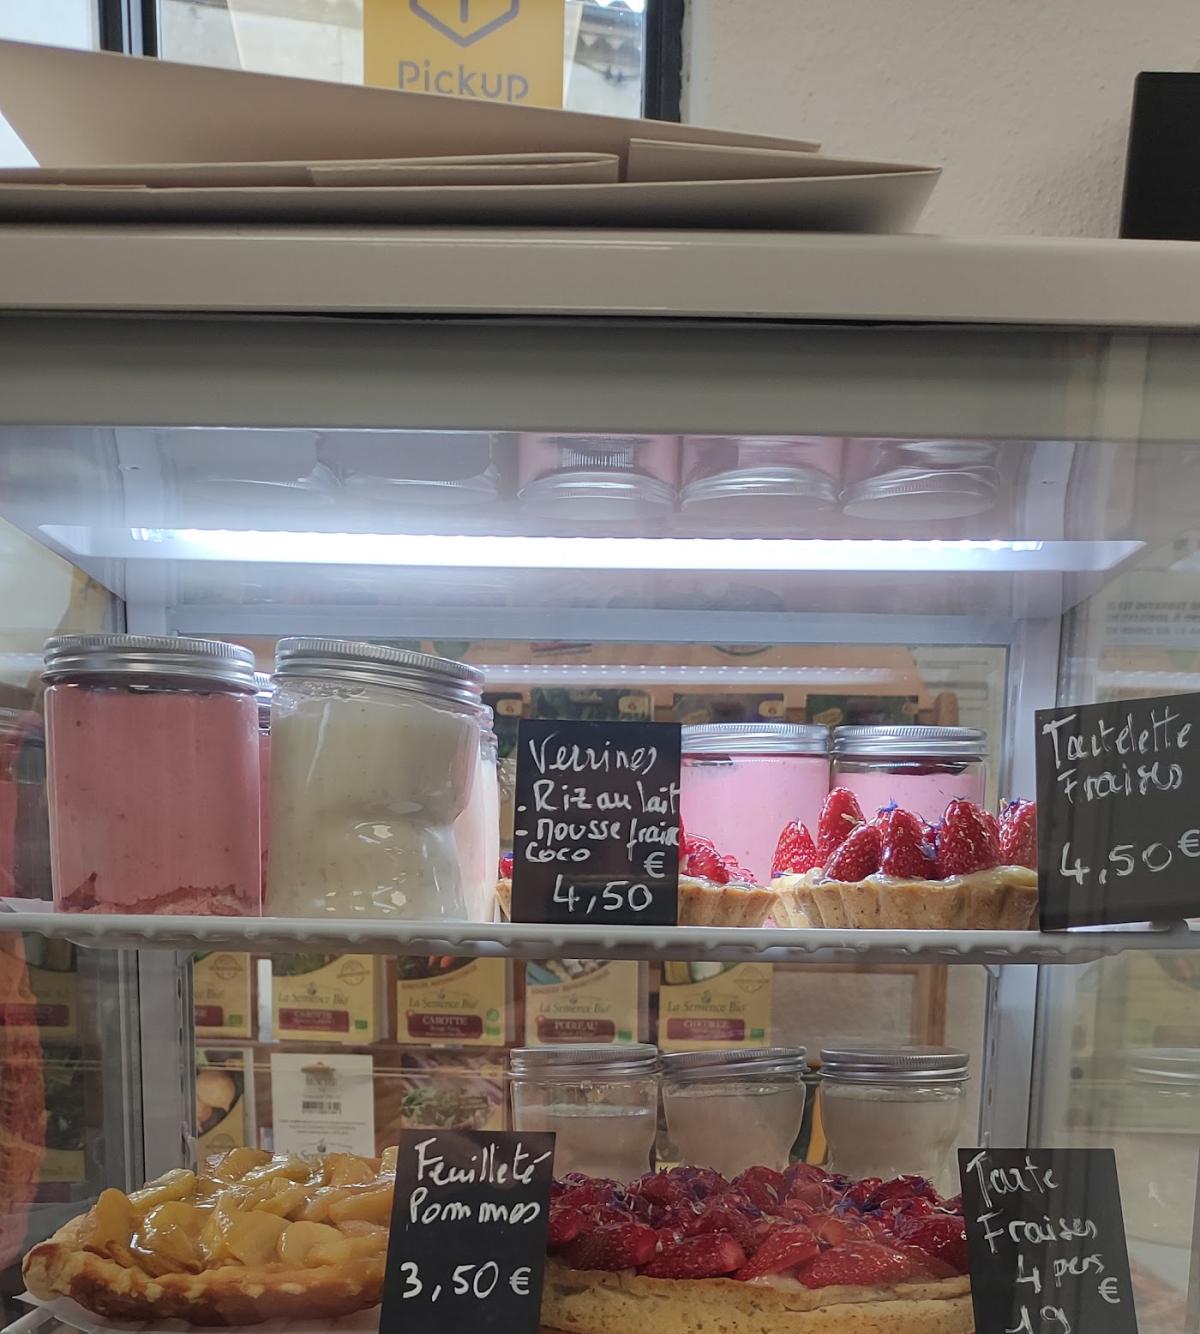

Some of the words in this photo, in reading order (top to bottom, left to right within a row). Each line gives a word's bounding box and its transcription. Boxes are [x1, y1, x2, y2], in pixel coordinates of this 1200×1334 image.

[398, 59, 529, 102] Pickup
[529, 732, 657, 775] Verrines
[533, 779, 592, 812] Riz
[596, 791, 632, 810] au
[636, 780, 681, 814] lait
[643, 851, 666, 879] €
[553, 874, 653, 914] 4,50
[414, 1137, 552, 1186] Feuilleté
[966, 1151, 1059, 1208] Tarte
[409, 1186, 541, 1224] Pommes
[976, 1208, 1097, 1254] Fraises
[400, 1260, 499, 1302] 3,50
[509, 1266, 531, 1295] €
[1016, 1254, 1042, 1294] 4
[1098, 1277, 1120, 1303] €
